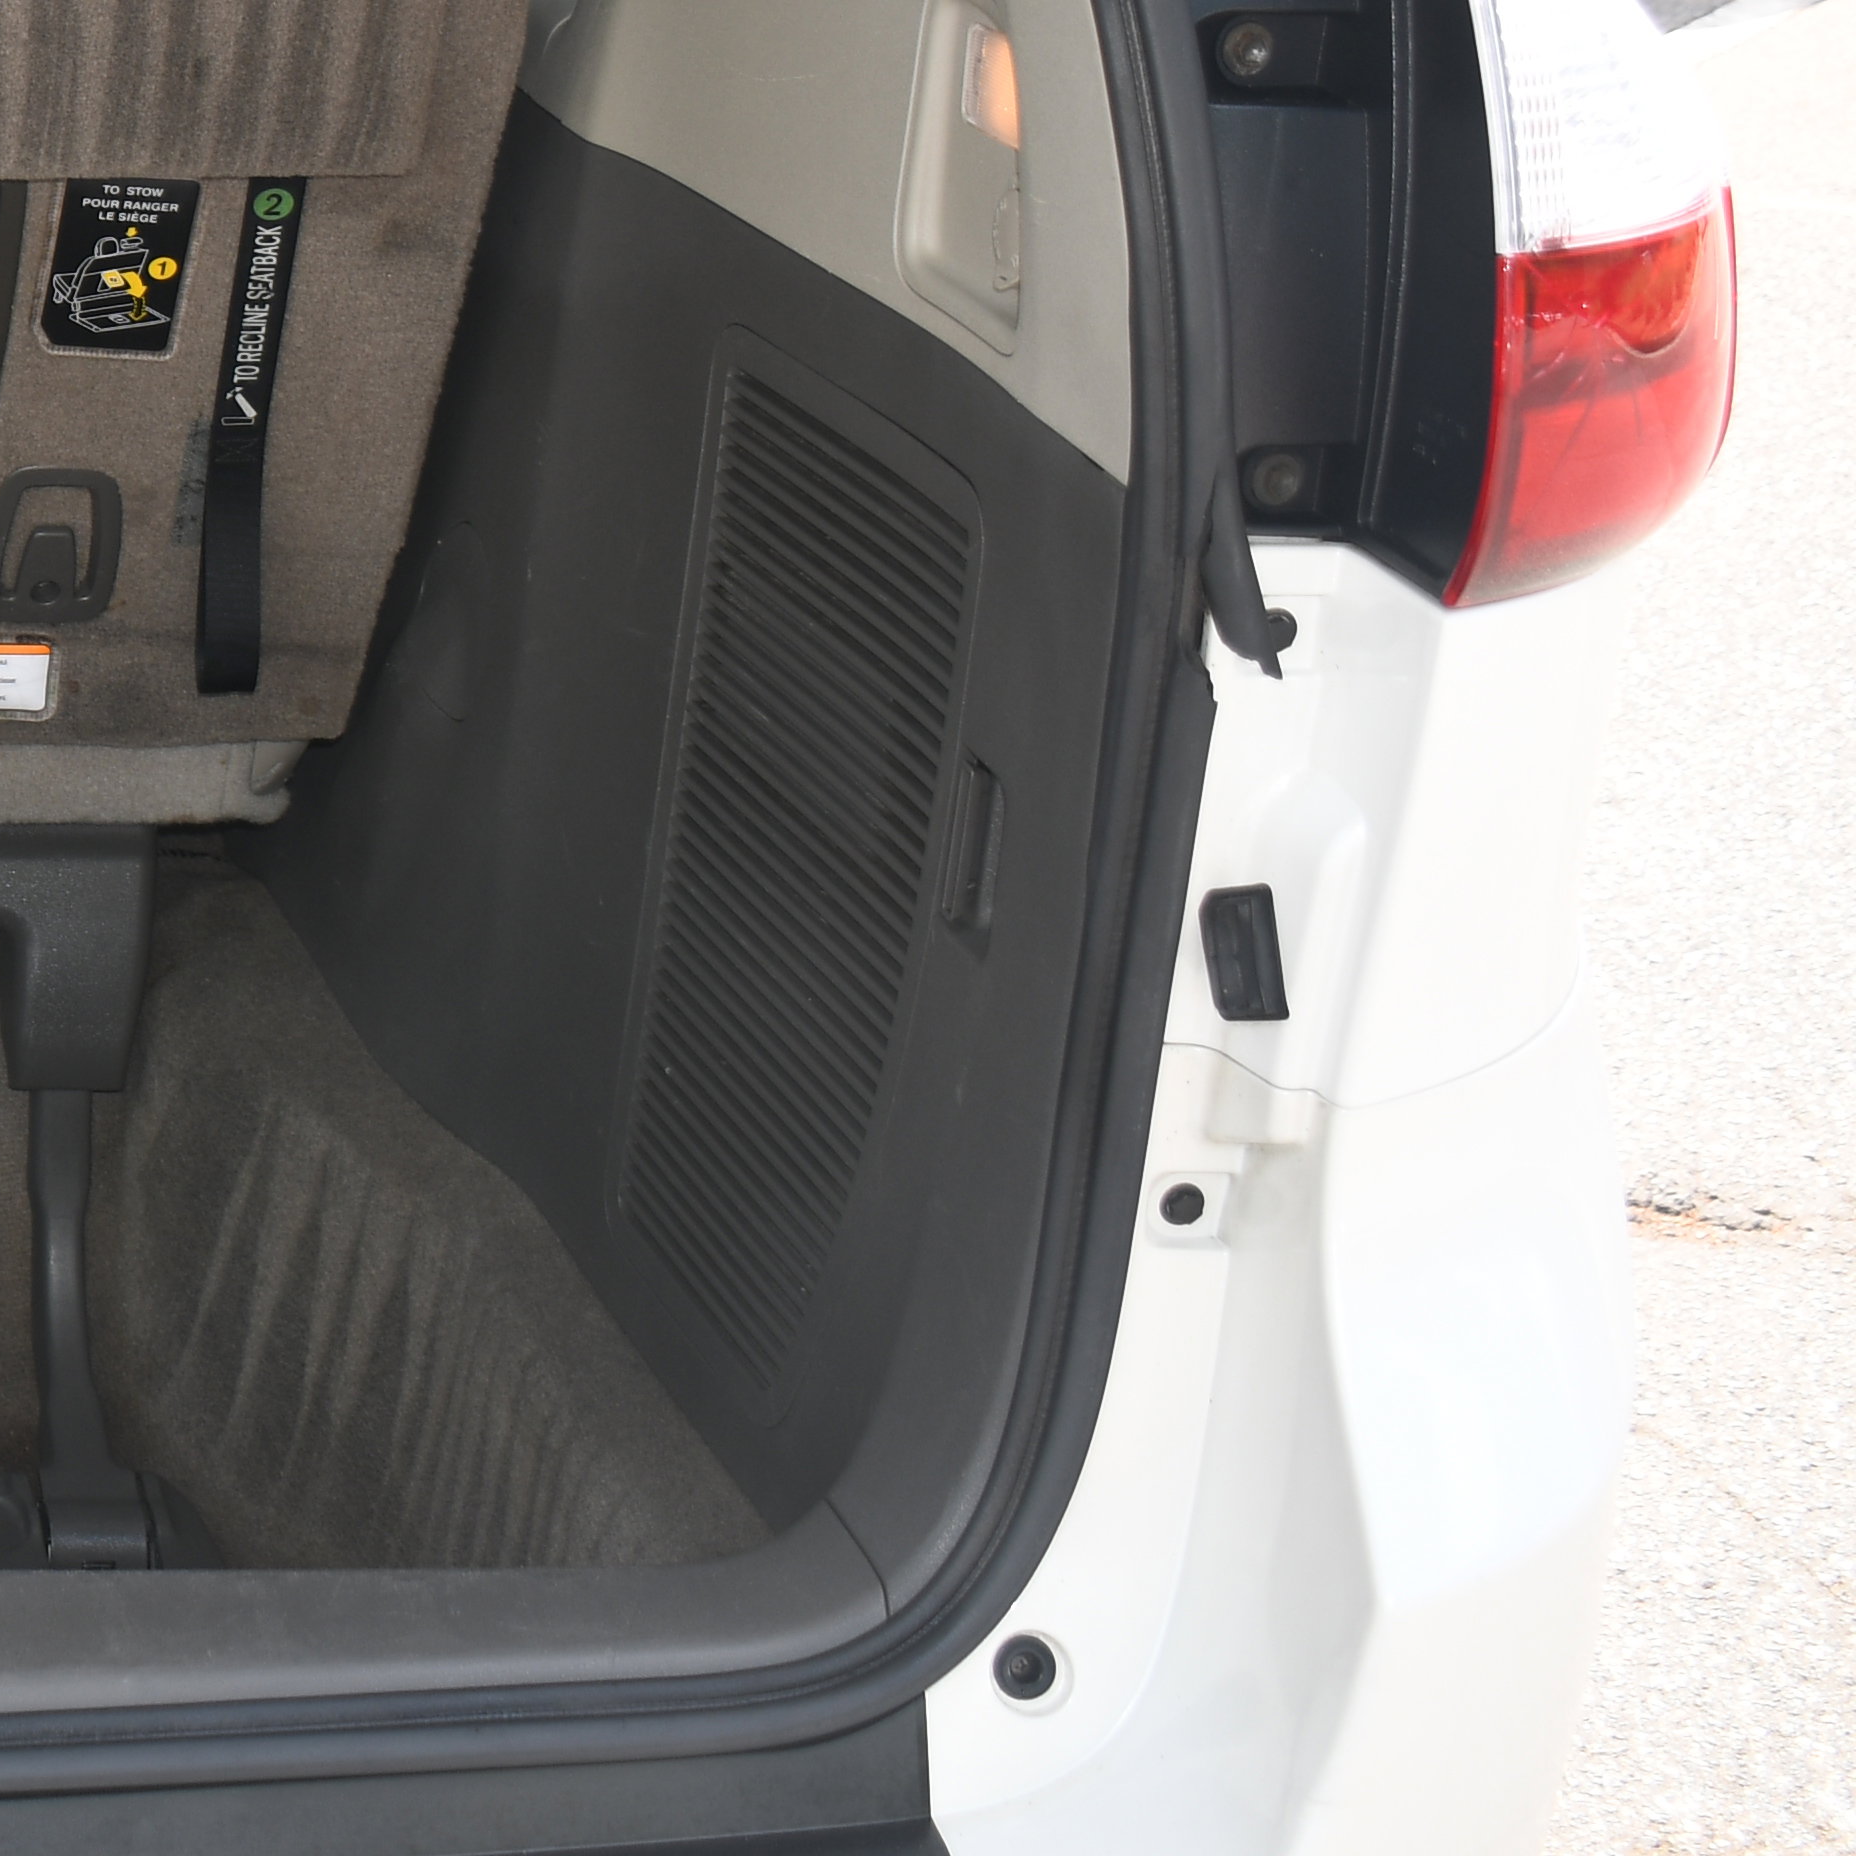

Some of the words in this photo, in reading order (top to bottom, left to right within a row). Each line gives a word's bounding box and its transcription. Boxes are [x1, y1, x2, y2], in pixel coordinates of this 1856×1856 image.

[102, 184, 120, 195] TO
[126, 186, 164, 197] STOW
[82, 197, 120, 209] POUR
[123, 200, 179, 212] RANGER
[262, 193, 283, 216] 2
[98, 211, 115, 220] LE
[118, 211, 158, 223] SIÈGE
[157, 261, 167, 276] 1
[246, 225, 283, 300] SEATBACK
[236, 302, 270, 364] RECLINE
[233, 365, 260, 383] TO
